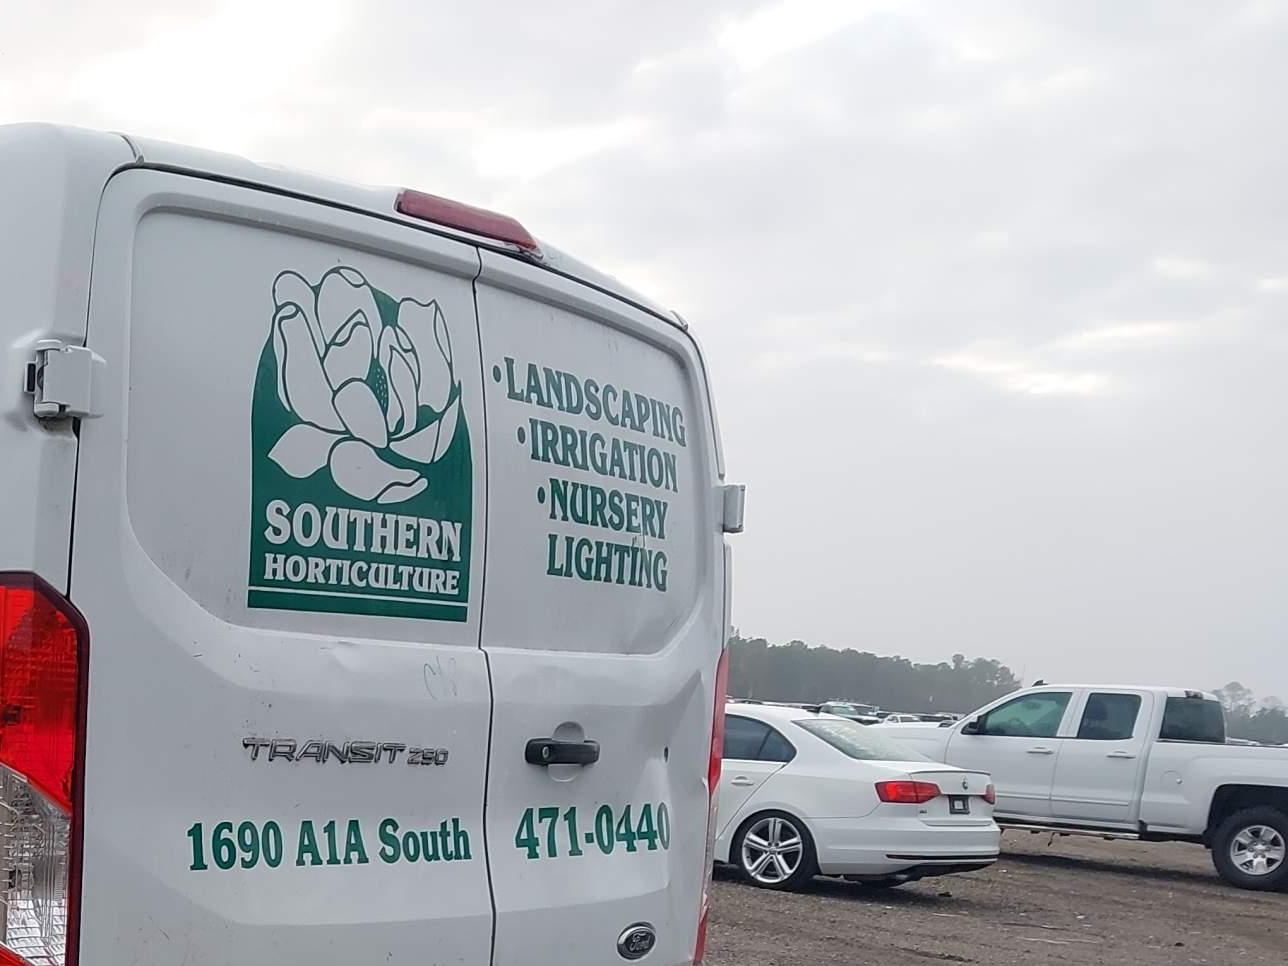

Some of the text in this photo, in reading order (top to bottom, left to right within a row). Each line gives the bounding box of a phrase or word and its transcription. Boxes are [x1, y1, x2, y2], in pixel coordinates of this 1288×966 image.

[505, 356, 687, 447] LANDSCAPING
[528, 417, 679, 493] IRRIGATION
[264, 498, 462, 562] SOUTHERN
[548, 478, 669, 539] NURSERY
[263, 552, 460, 594] HORTICULTURE
[546, 533, 668, 592] LIGHTING
[242, 736, 406, 764] TRANSIT
[186, 817, 473, 871] 1690 A1A South
[514, 801, 672, 860] 471-0440
